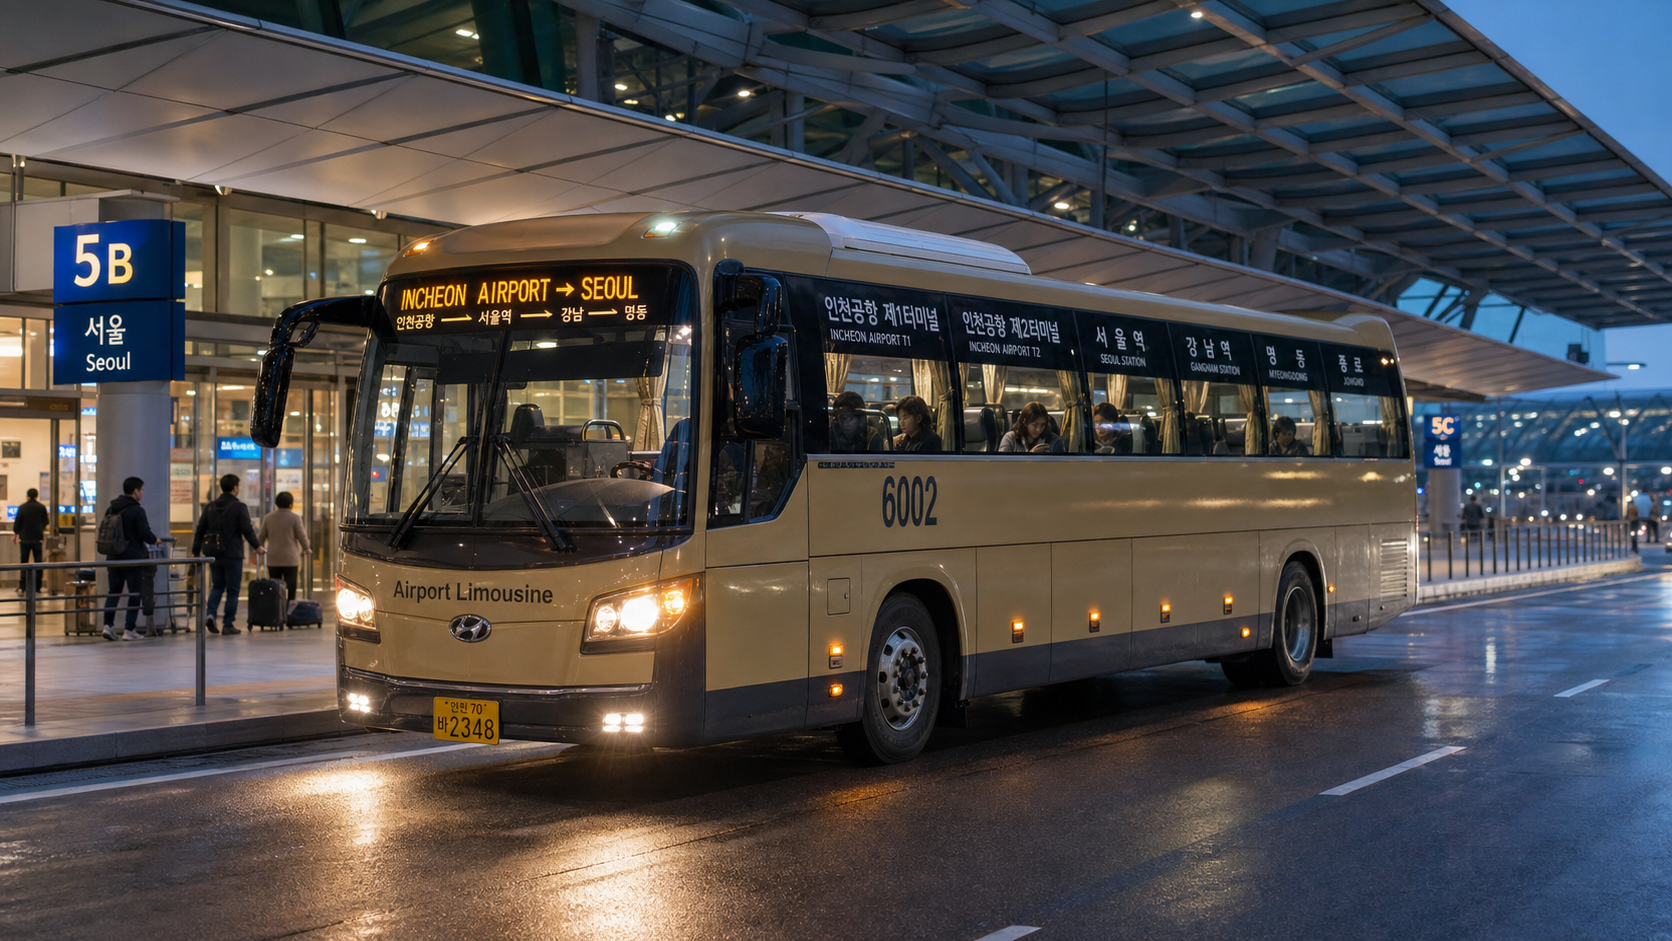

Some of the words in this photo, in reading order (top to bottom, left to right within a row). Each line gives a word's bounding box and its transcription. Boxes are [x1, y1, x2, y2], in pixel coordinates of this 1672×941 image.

[400, 284, 467, 311] INCHEON
[477, 278, 551, 305] AIRPORT
[581, 275, 639, 300] SEOUL
[396, 313, 436, 331] 인천공항
[478, 309, 512, 325] 서울역
[560, 307, 584, 322] 강남
[624, 304, 648, 321] 명동
[824, 295, 879, 326] 인천공항
[883, 302, 940, 332] 제1터미널
[84, 314, 126, 346] 서울
[830, 328, 867, 343] INCHEON
[868, 331, 901, 346] AIRPORT
[902, 334, 912, 347] T1
[962, 311, 1007, 338] 인천공항
[1009, 316, 1061, 344] 제2터미널
[969, 340, 1001, 354] INCHEON
[1002, 344, 1031, 357] AIRPORT
[1031, 346, 1042, 358] T2
[86, 352, 131, 372] Seoul
[1100, 353, 1121, 366] SEOUL
[1121, 355, 1147, 368] STATION
[1219, 364, 1241, 376] STATION
[1431, 416, 1455, 436] 5C
[882, 475, 938, 528] 6002
[393, 580, 451, 604] Airport
[456, 582, 554, 604] Limousine
[470, 703, 483, 715] 70
